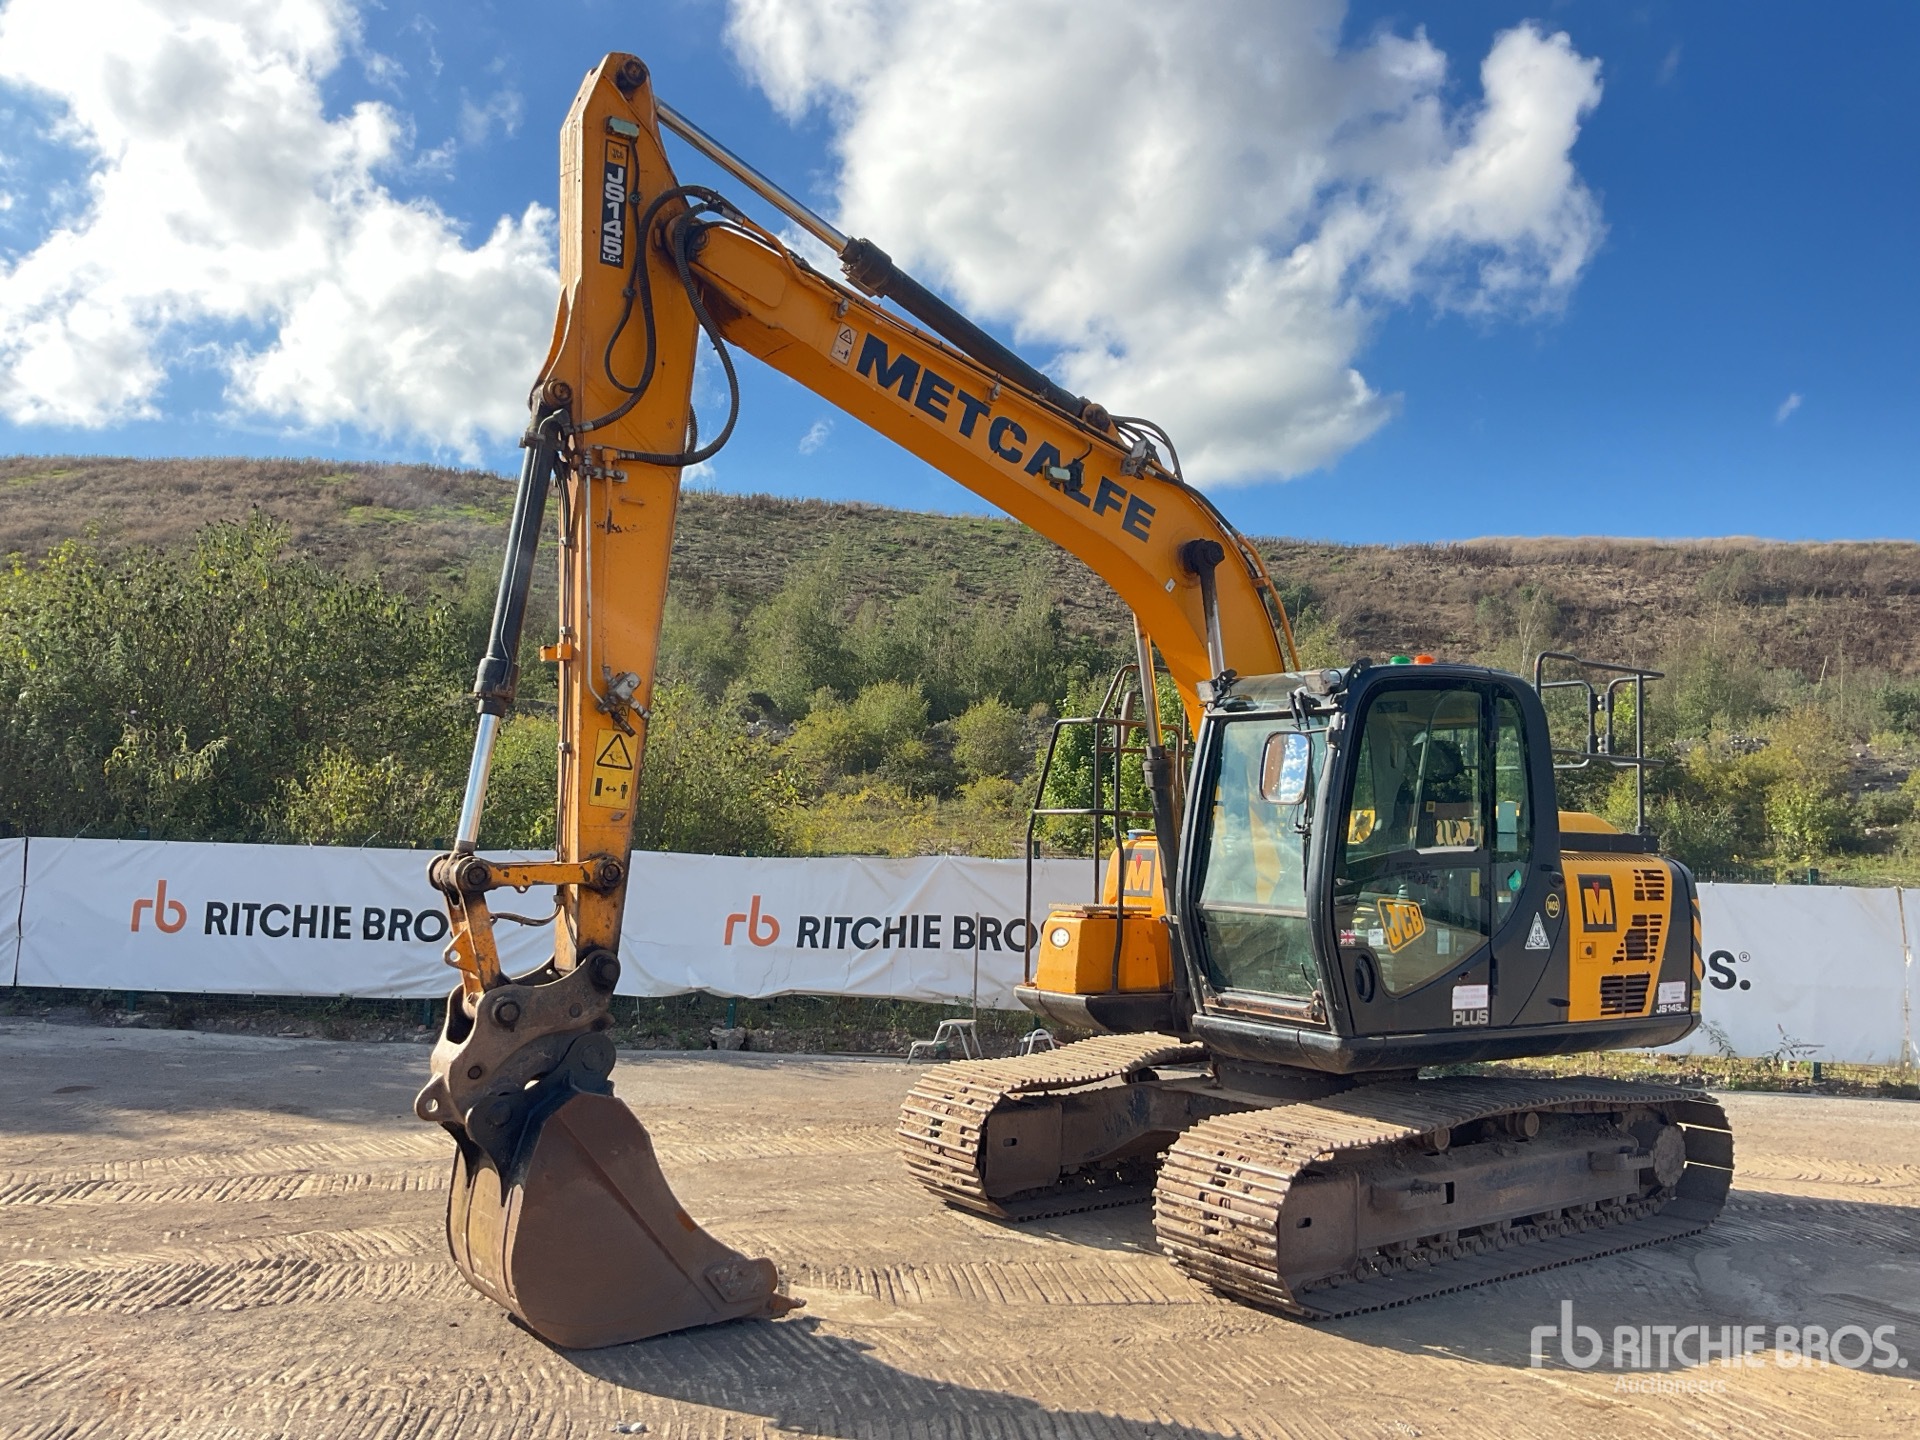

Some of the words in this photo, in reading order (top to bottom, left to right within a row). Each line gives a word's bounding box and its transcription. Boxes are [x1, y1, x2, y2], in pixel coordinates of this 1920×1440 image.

[603, 167, 625, 256] JS145
[1124, 860, 1152, 891] M
[131, 880, 187, 933] rb
[205, 902, 351, 939] RITCHIE
[363, 907, 454, 942] BRO
[724, 895, 780, 947] rb
[797, 914, 941, 950] RITCHIE
[953, 915, 1046, 952] BRO
[1386, 904, 1422, 946] JCB
[1584, 888, 1613, 924] M
[1453, 1010, 1488, 1026] PLUS
